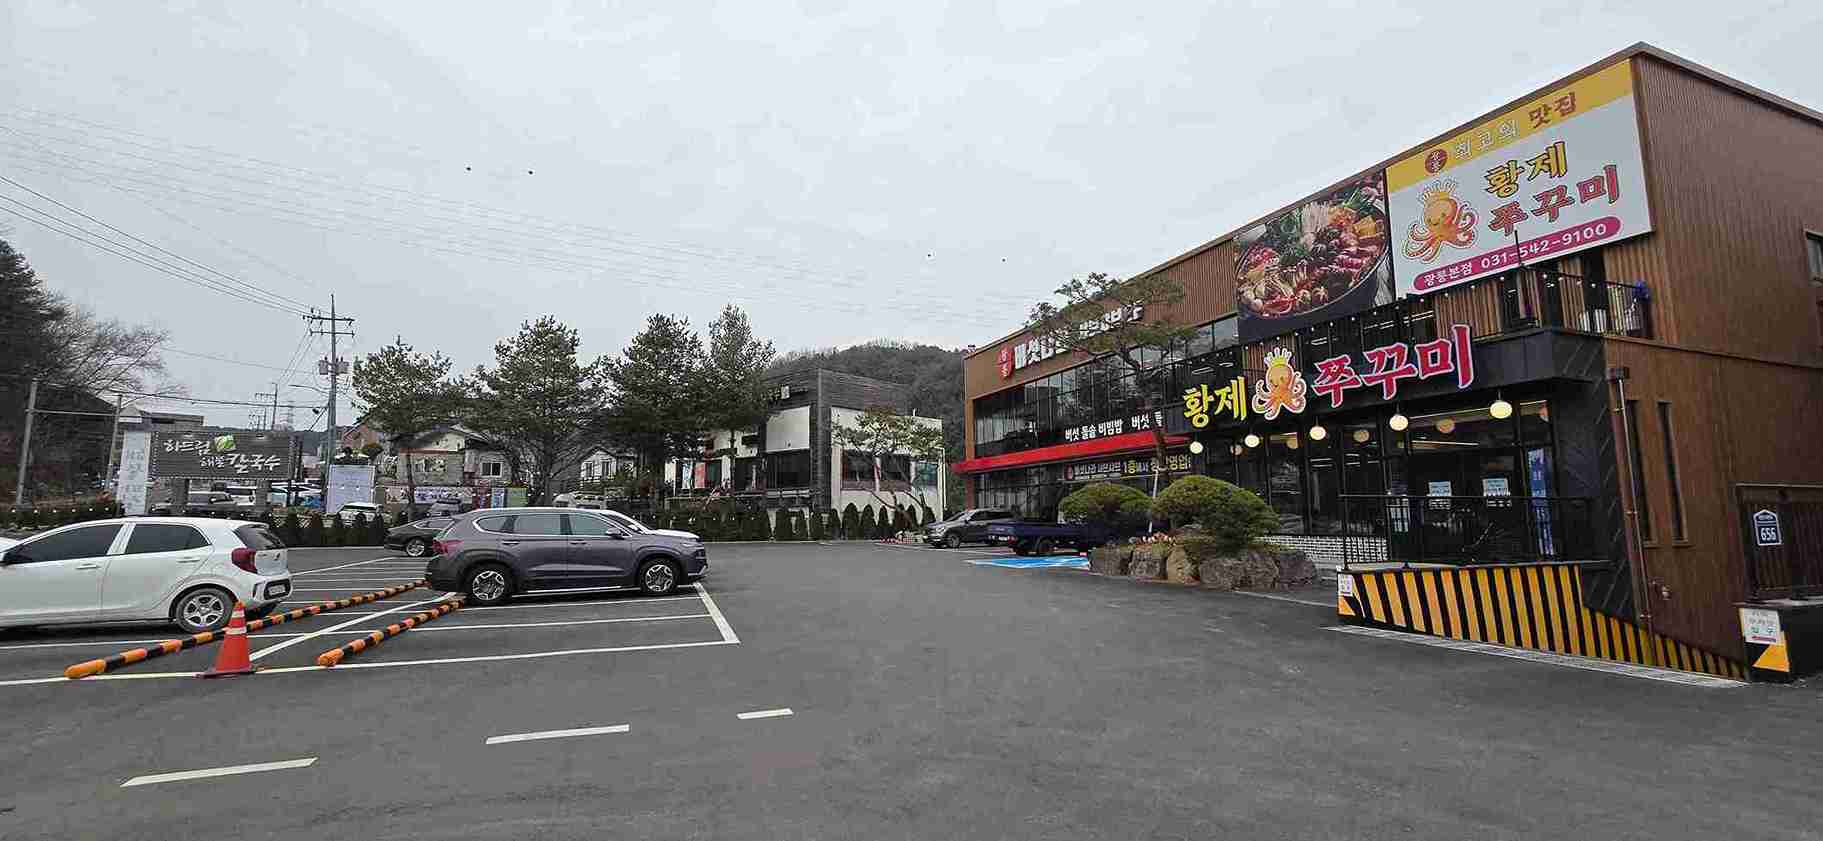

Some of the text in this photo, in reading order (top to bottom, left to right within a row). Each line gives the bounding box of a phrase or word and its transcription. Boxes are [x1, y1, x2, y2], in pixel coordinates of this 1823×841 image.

[1528, 92, 1577, 129] 맛집
[1484, 141, 1569, 198] 황제
[1488, 165, 1621, 237] 쭈꾸미
[1481, 222, 1608, 268] 031-542-9100
[1183, 323, 1475, 429] 황제 쭈꾸미
[1098, 419, 1124, 436] 비빔밥
[1131, 412, 1151, 430] 버섯
[225, 453, 281, 474] 칼국수
